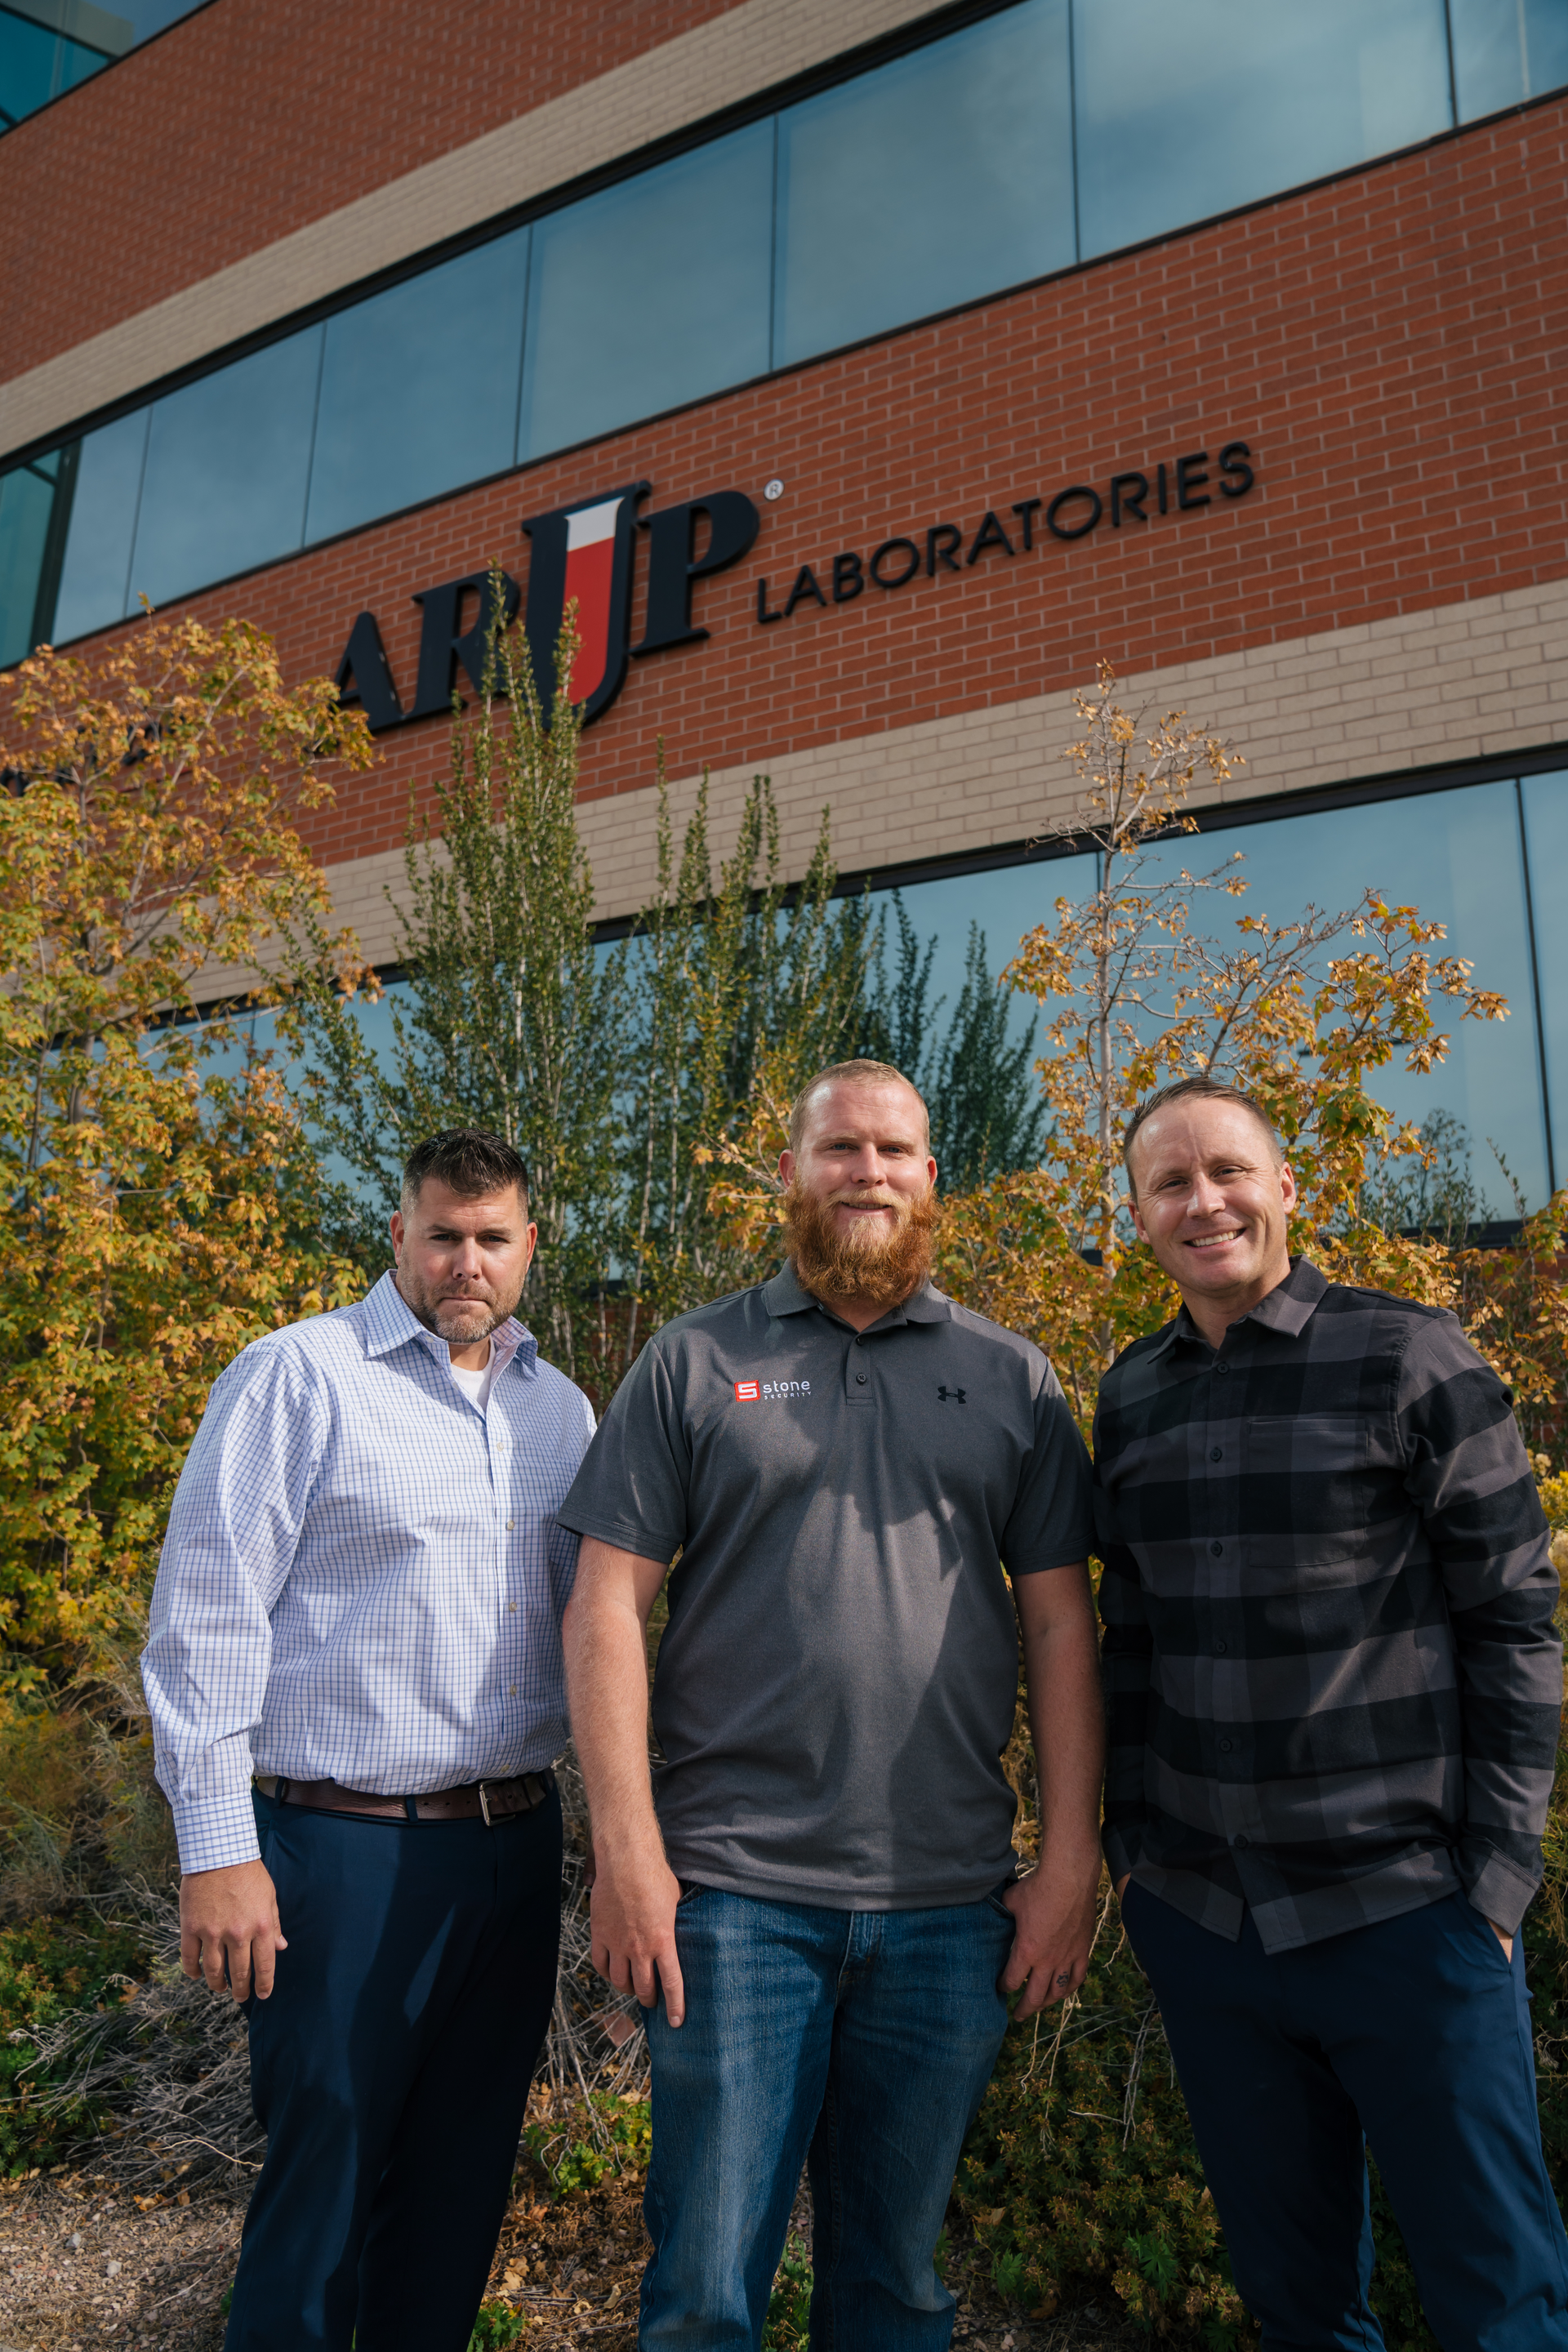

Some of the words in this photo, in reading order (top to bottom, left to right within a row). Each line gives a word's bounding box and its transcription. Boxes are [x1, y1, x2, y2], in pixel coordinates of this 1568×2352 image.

[315, 479, 760, 745] ARUP
[757, 441, 1254, 625] LABORATORIES
[763, 1380, 810, 1393] stone
[764, 1391, 811, 1400] SECURITY
